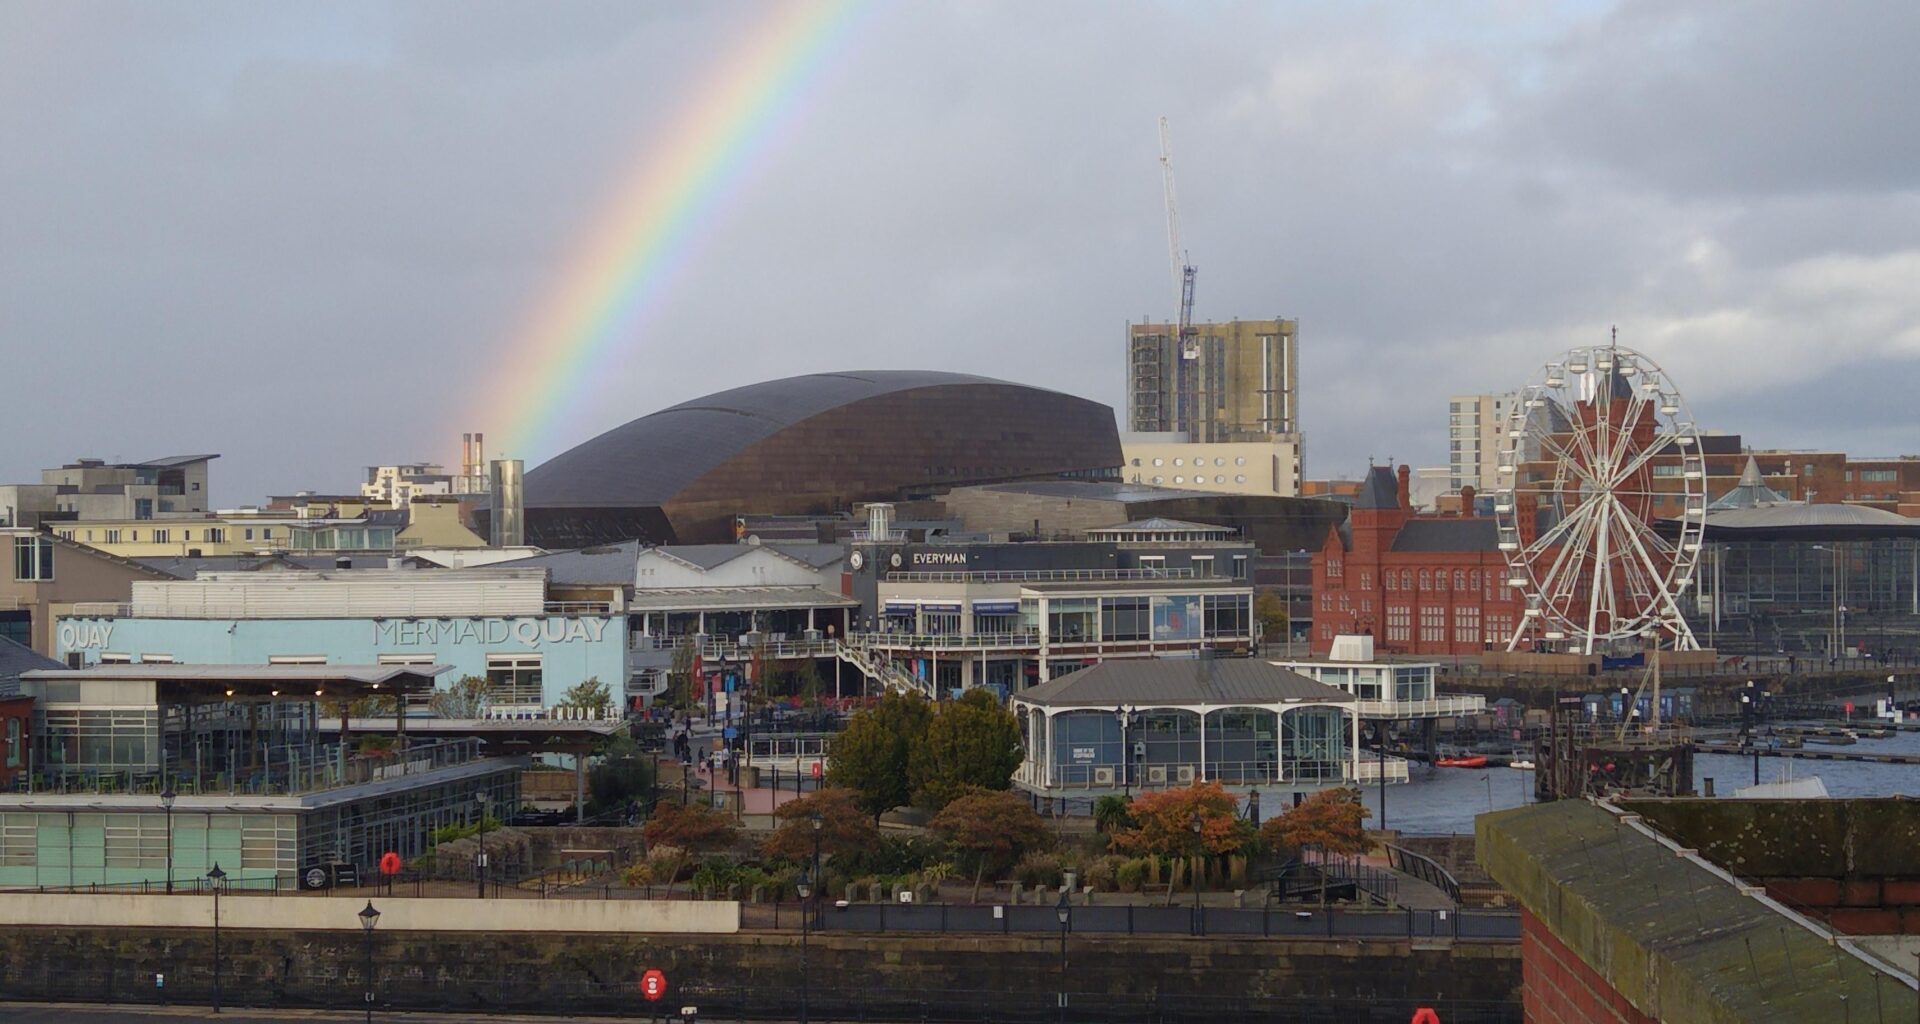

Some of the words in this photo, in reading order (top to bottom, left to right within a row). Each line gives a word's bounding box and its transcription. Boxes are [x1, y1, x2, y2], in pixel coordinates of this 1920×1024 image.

[913, 553, 967, 564] EVERYMAN
[61, 624, 114, 650] QUAY
[373, 619, 510, 646] MERMAID
[512, 617, 610, 649] QUAY
